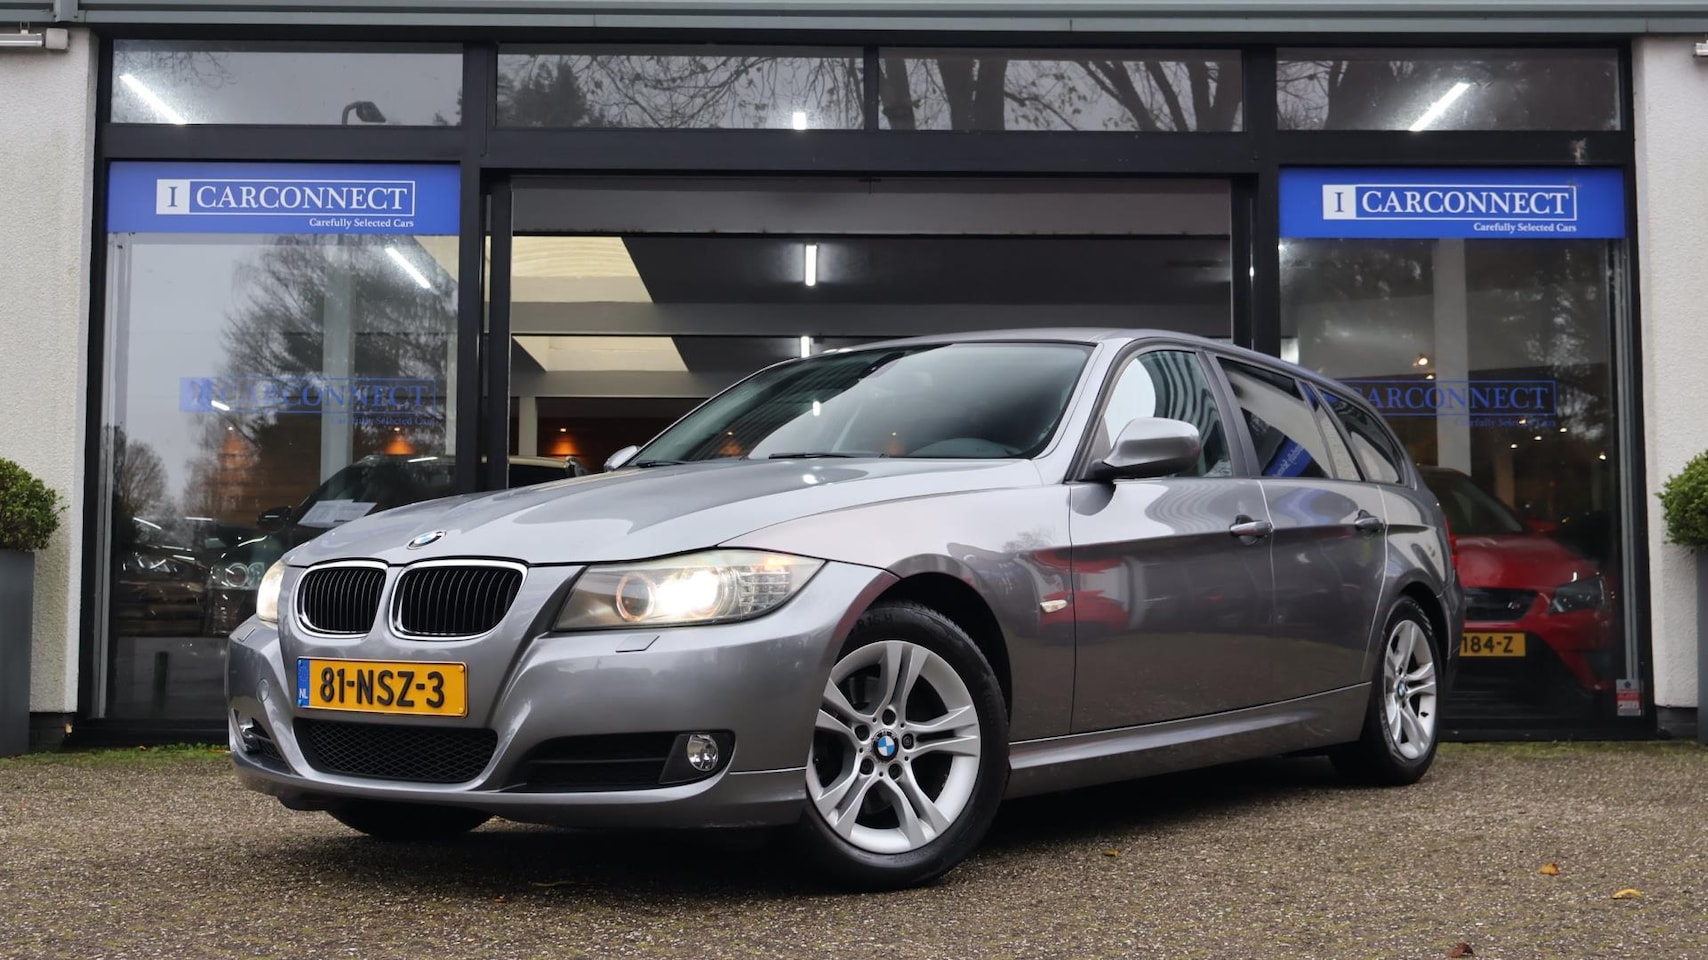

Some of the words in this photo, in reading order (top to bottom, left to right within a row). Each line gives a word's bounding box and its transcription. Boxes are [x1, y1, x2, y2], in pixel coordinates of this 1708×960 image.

[168, 186, 178, 208] I
[196, 185, 408, 210] CARCONNECT
[1334, 191, 1345, 213] I
[1362, 190, 1569, 214] CARCONNECT
[309, 217, 352, 230] Carefully
[353, 219, 391, 228] Selected
[393, 219, 414, 228] Cars
[1473, 222, 1516, 234] Carefully
[1517, 223, 1555, 232] Selected
[1556, 223, 1577, 233] Cars
[1353, 386, 1548, 409] ARCONNECT
[299, 687, 308, 699] NL
[320, 667, 444, 708] 81-NSZ-3
